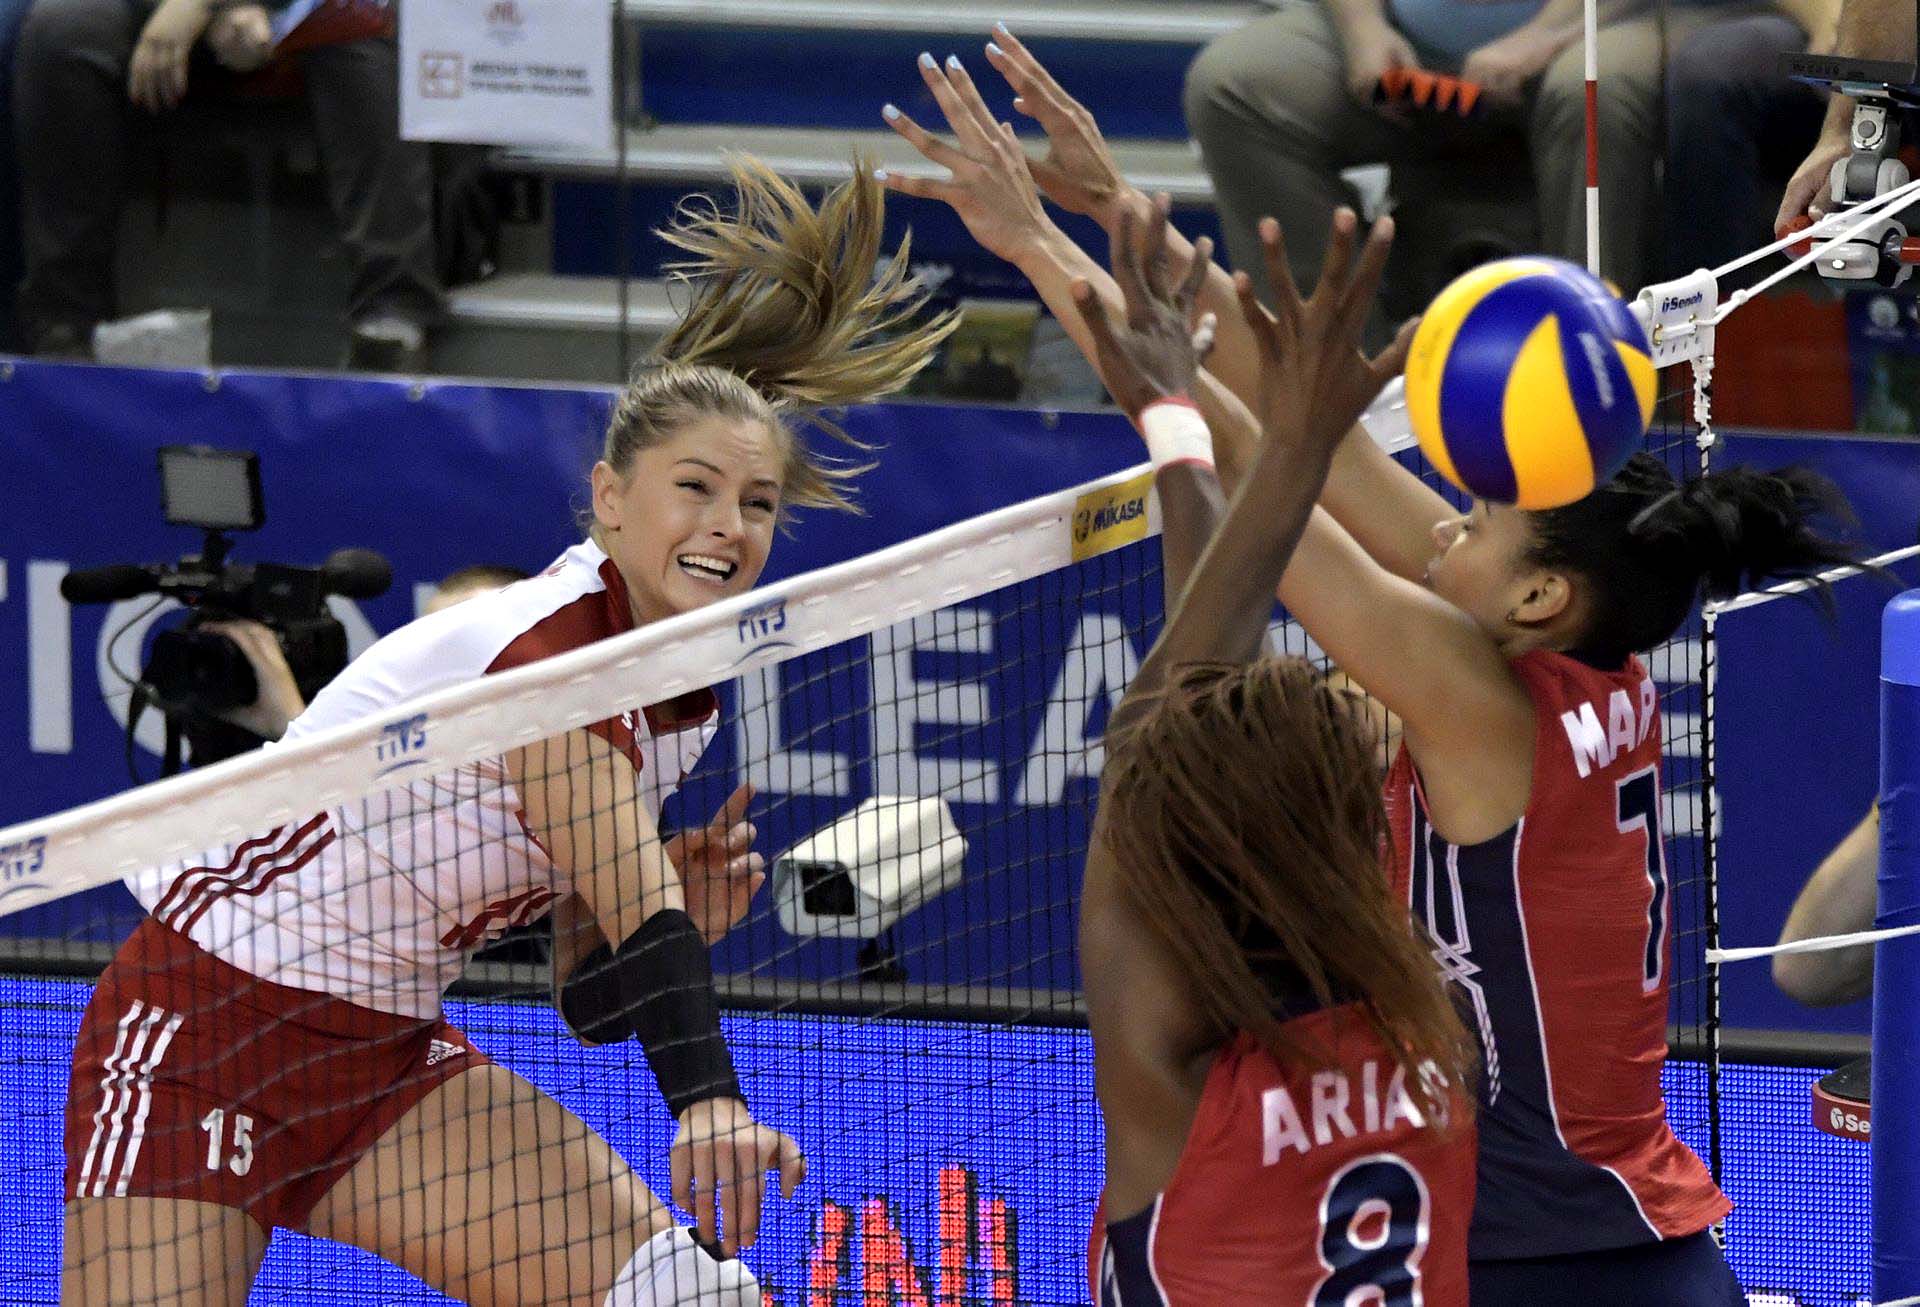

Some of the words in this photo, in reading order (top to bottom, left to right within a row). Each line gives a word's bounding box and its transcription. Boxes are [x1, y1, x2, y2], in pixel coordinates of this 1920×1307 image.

[1092, 496, 1145, 534] MIKASA
[1560, 676, 1658, 779] MAR
[200, 1107, 254, 1177] 15
[1261, 1060, 1449, 1168] ARIAS
[1305, 1152, 1431, 1307] 8
